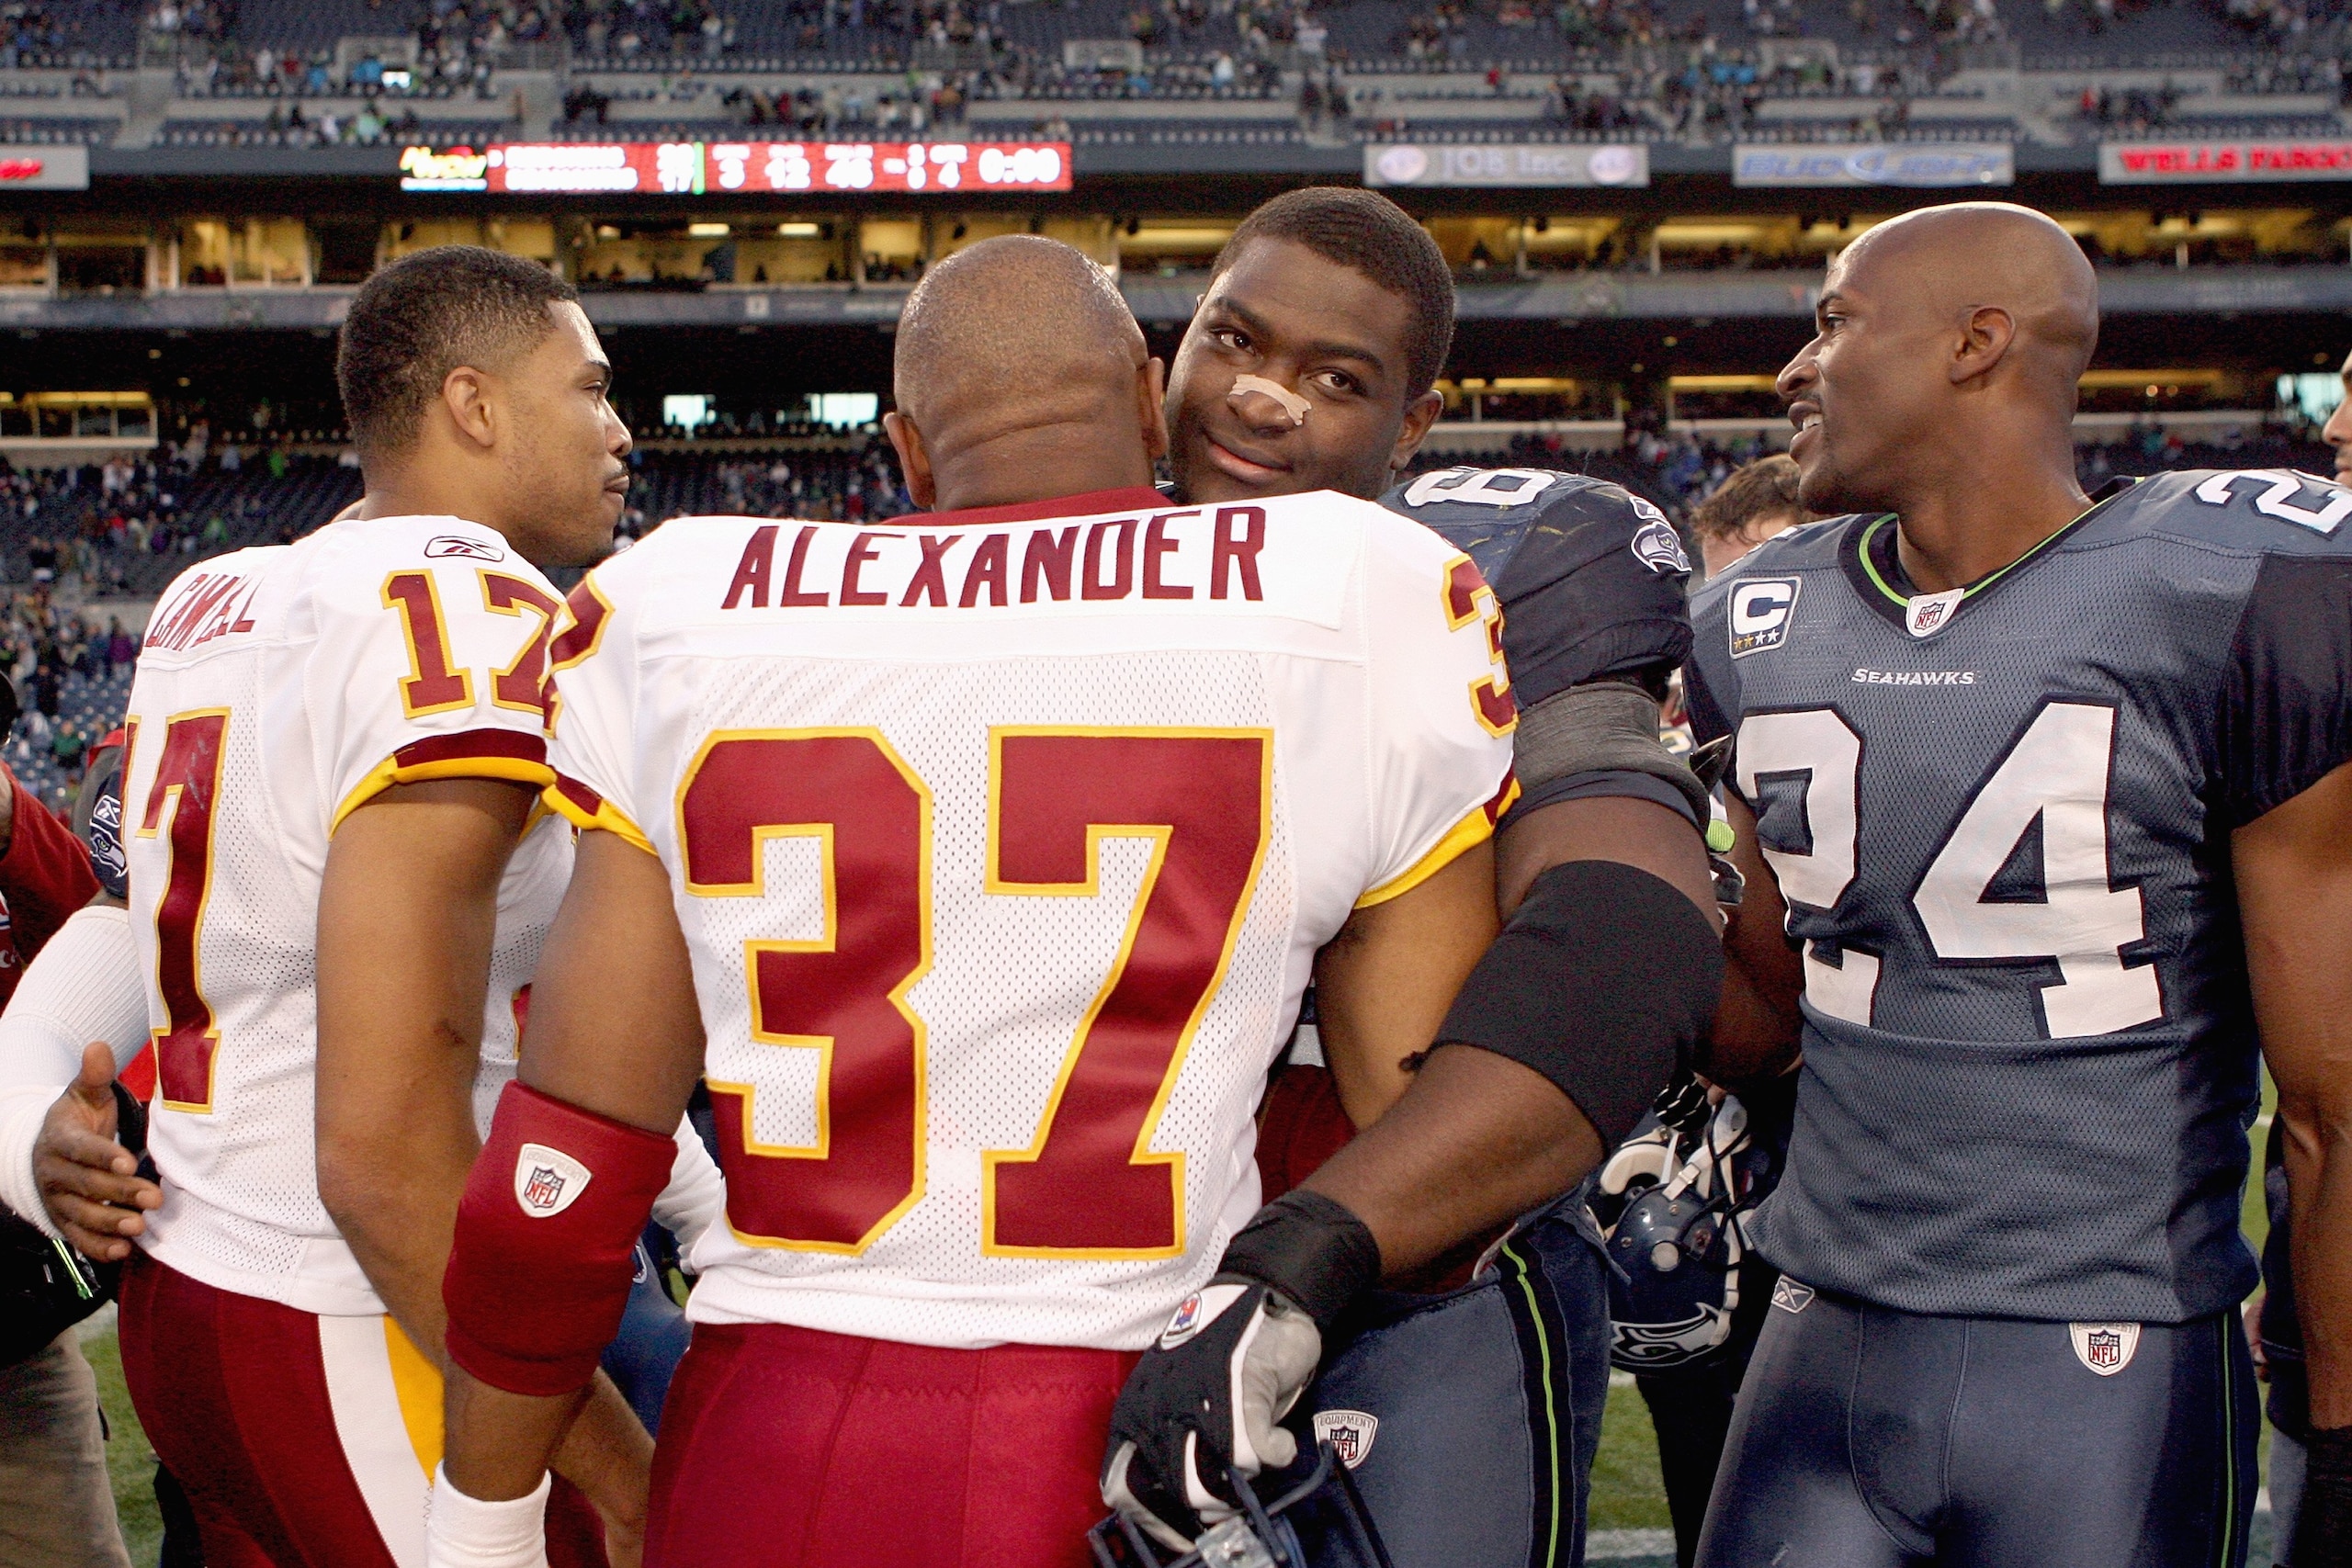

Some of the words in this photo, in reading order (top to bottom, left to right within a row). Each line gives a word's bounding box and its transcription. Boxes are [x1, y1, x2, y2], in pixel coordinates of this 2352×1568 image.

[764, 157, 811, 188] 12
[2120, 147, 2242, 173] WELLS
[721, 506, 1265, 610] ALEXANDER
[1733, 582, 1792, 636] C
[1915, 611, 1940, 628] NFL
[379, 567, 570, 719] 17
[1851, 668, 1976, 685] SEAHAWKS
[1736, 701, 2164, 1040] 24
[674, 726, 1274, 1258] 37
[525, 1181, 555, 1205] NFL
[2090, 1346, 2117, 1364] NFL
[1319, 1416, 1374, 1428] EQUIPMENT
